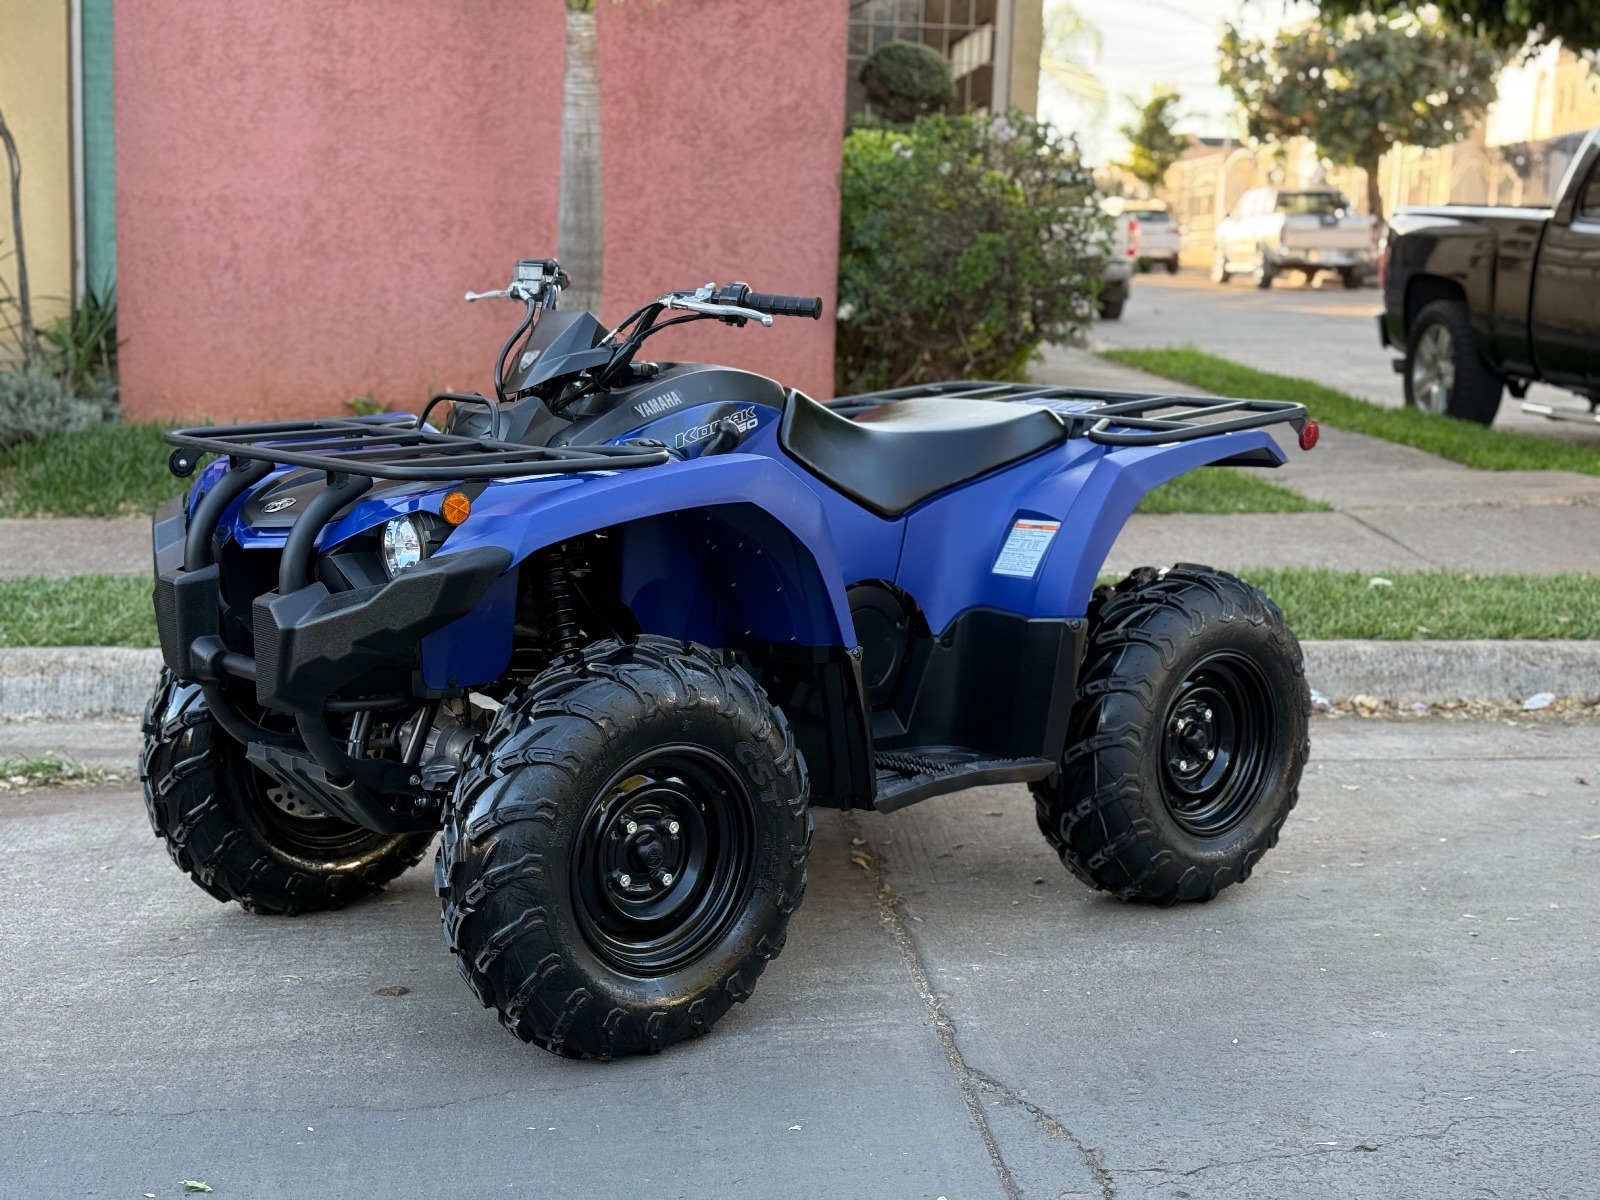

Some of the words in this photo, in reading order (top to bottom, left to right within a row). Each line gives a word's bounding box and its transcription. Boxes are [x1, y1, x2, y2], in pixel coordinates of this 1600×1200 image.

[634, 391, 682, 418] YAMAHA
[675, 405, 757, 449] KODAK
[735, 741, 782, 807] CST
